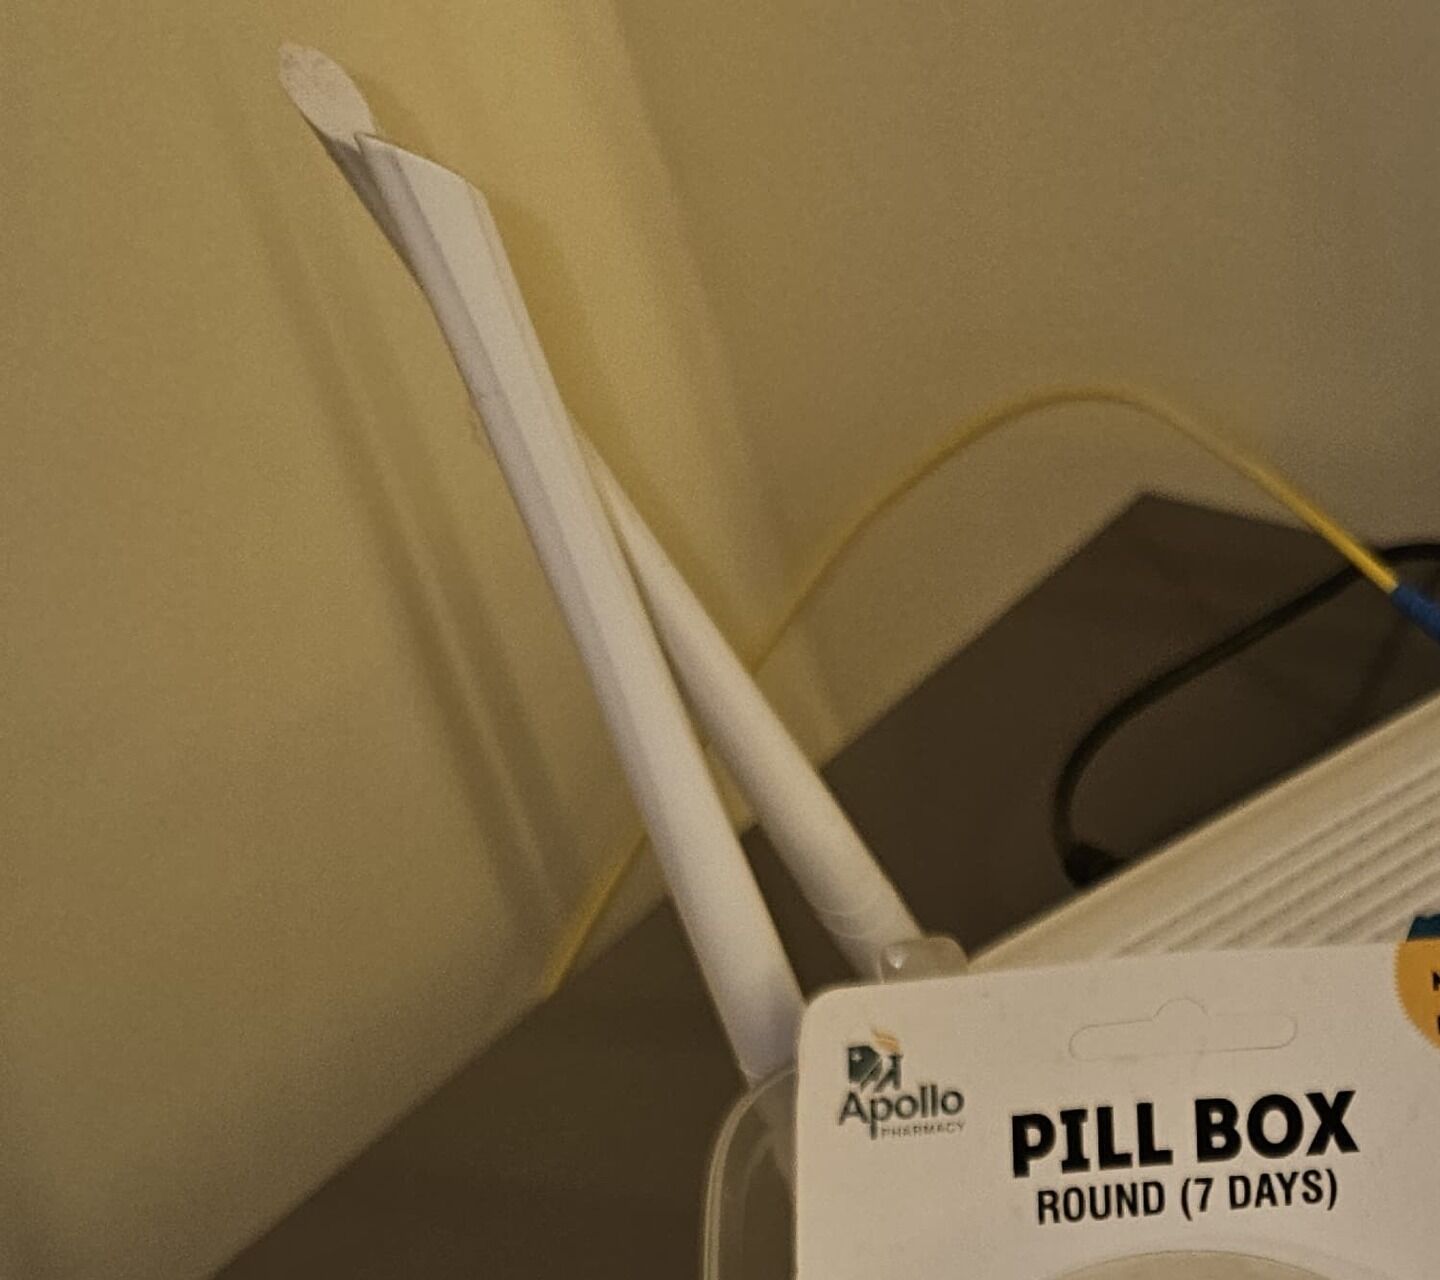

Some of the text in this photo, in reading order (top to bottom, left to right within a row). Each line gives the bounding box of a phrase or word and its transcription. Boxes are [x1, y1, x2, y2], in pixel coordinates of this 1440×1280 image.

[838, 1082, 966, 1141] Apollo
[1011, 1091, 1360, 1177] PILL BOX
[1036, 1169, 1341, 1225] ROUND (7 DAYS)
